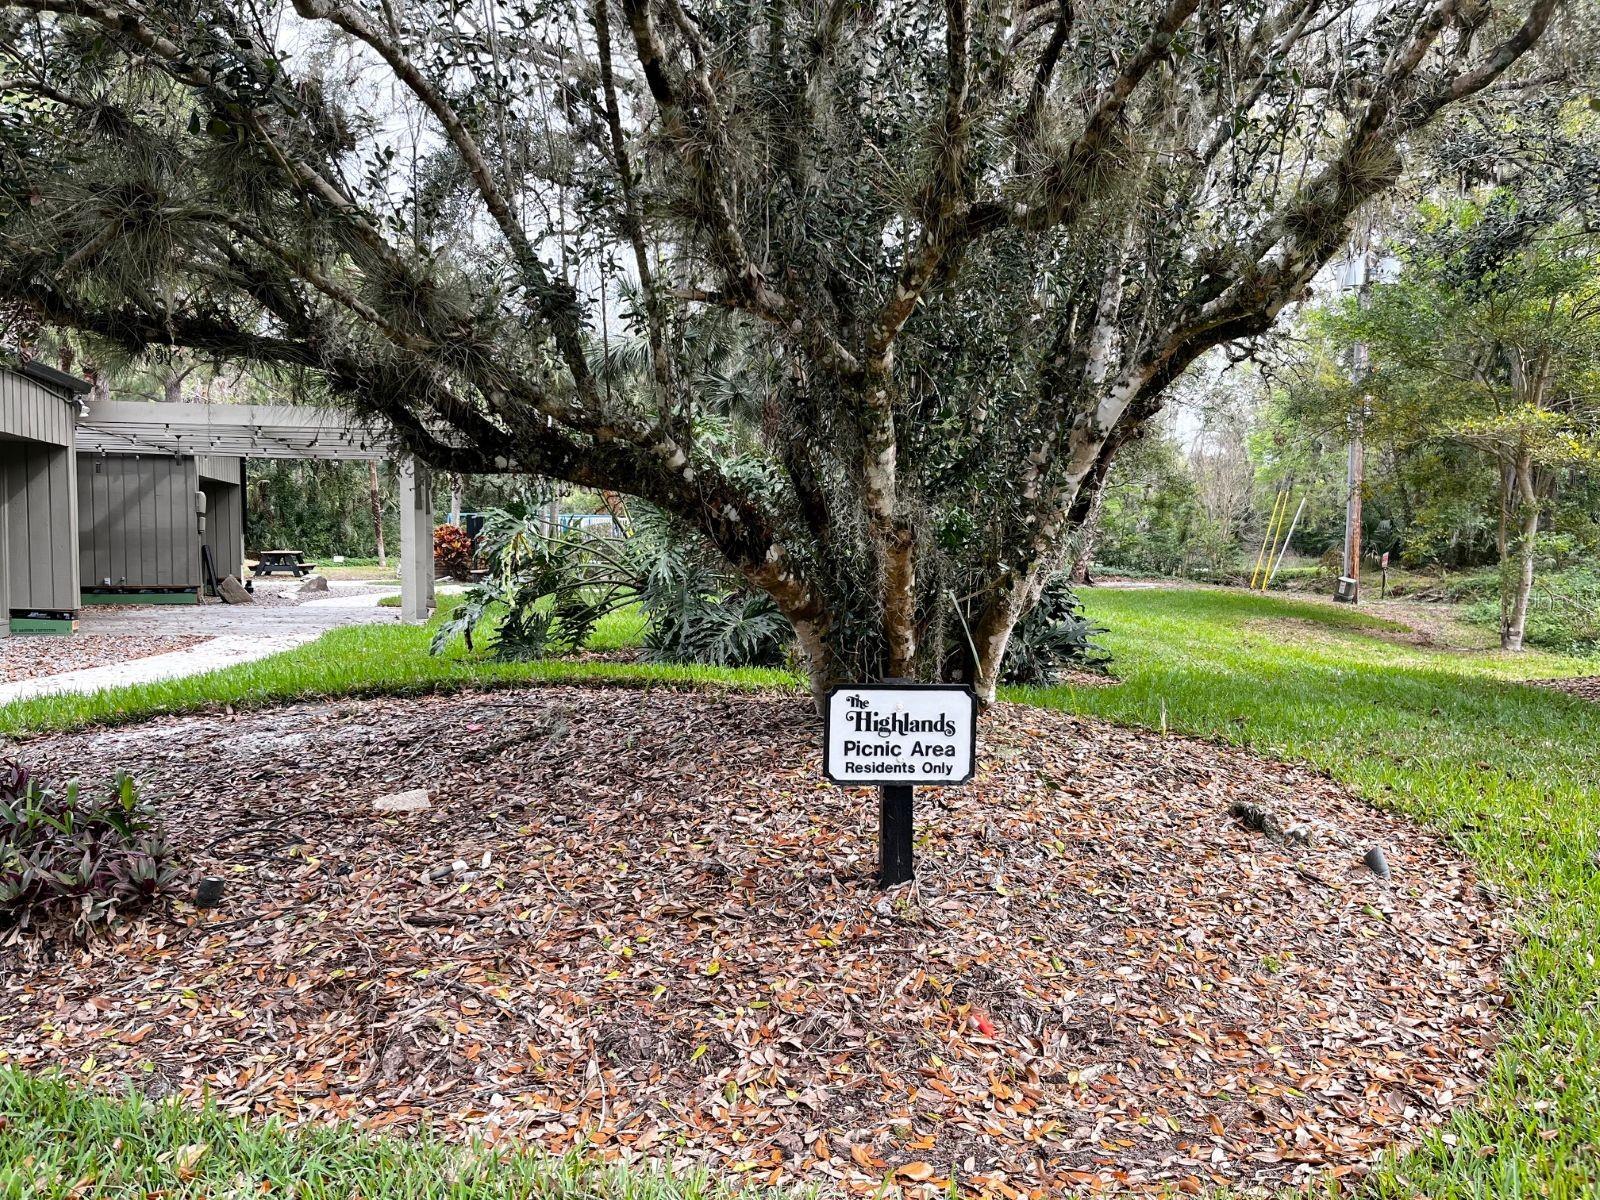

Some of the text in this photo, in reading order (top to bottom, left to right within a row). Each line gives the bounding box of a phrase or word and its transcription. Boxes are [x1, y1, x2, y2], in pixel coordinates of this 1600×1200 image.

[845, 693, 870, 709] The
[845, 711, 956, 738] Highlands
[844, 740, 956, 757] Picnic Area
[845, 761, 953, 776] Residents Only
